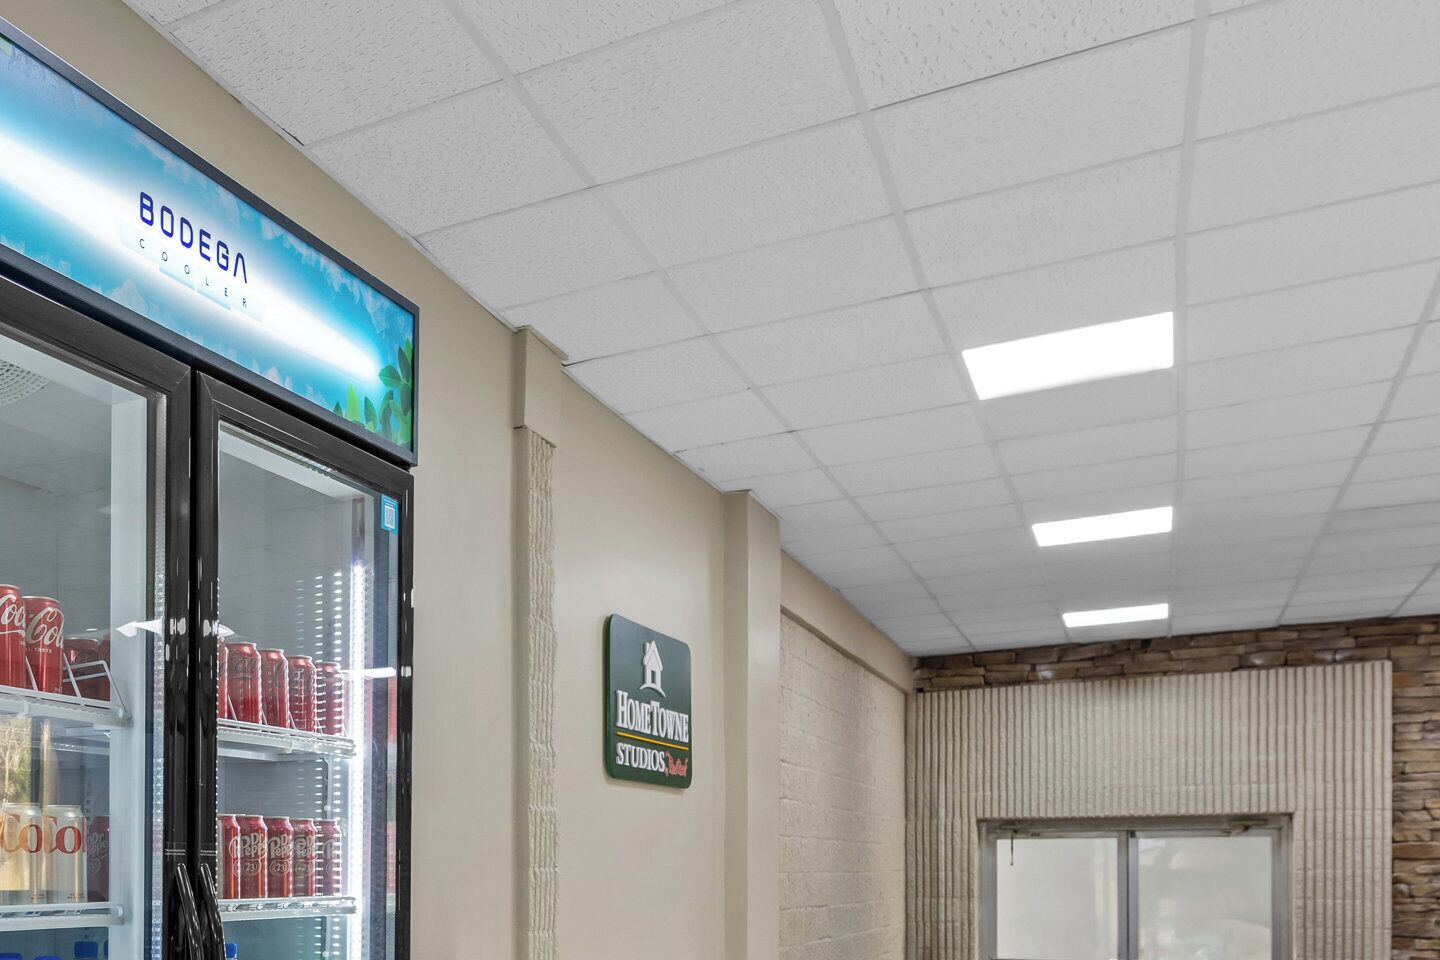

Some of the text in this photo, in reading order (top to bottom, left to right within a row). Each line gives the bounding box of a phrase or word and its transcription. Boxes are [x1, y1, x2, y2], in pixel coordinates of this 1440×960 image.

[140, 191, 247, 284] BODEGA
[140, 238, 247, 308] COOLER
[25, 607, 64, 648] Col
[616, 743, 666, 773] STUDIOS
